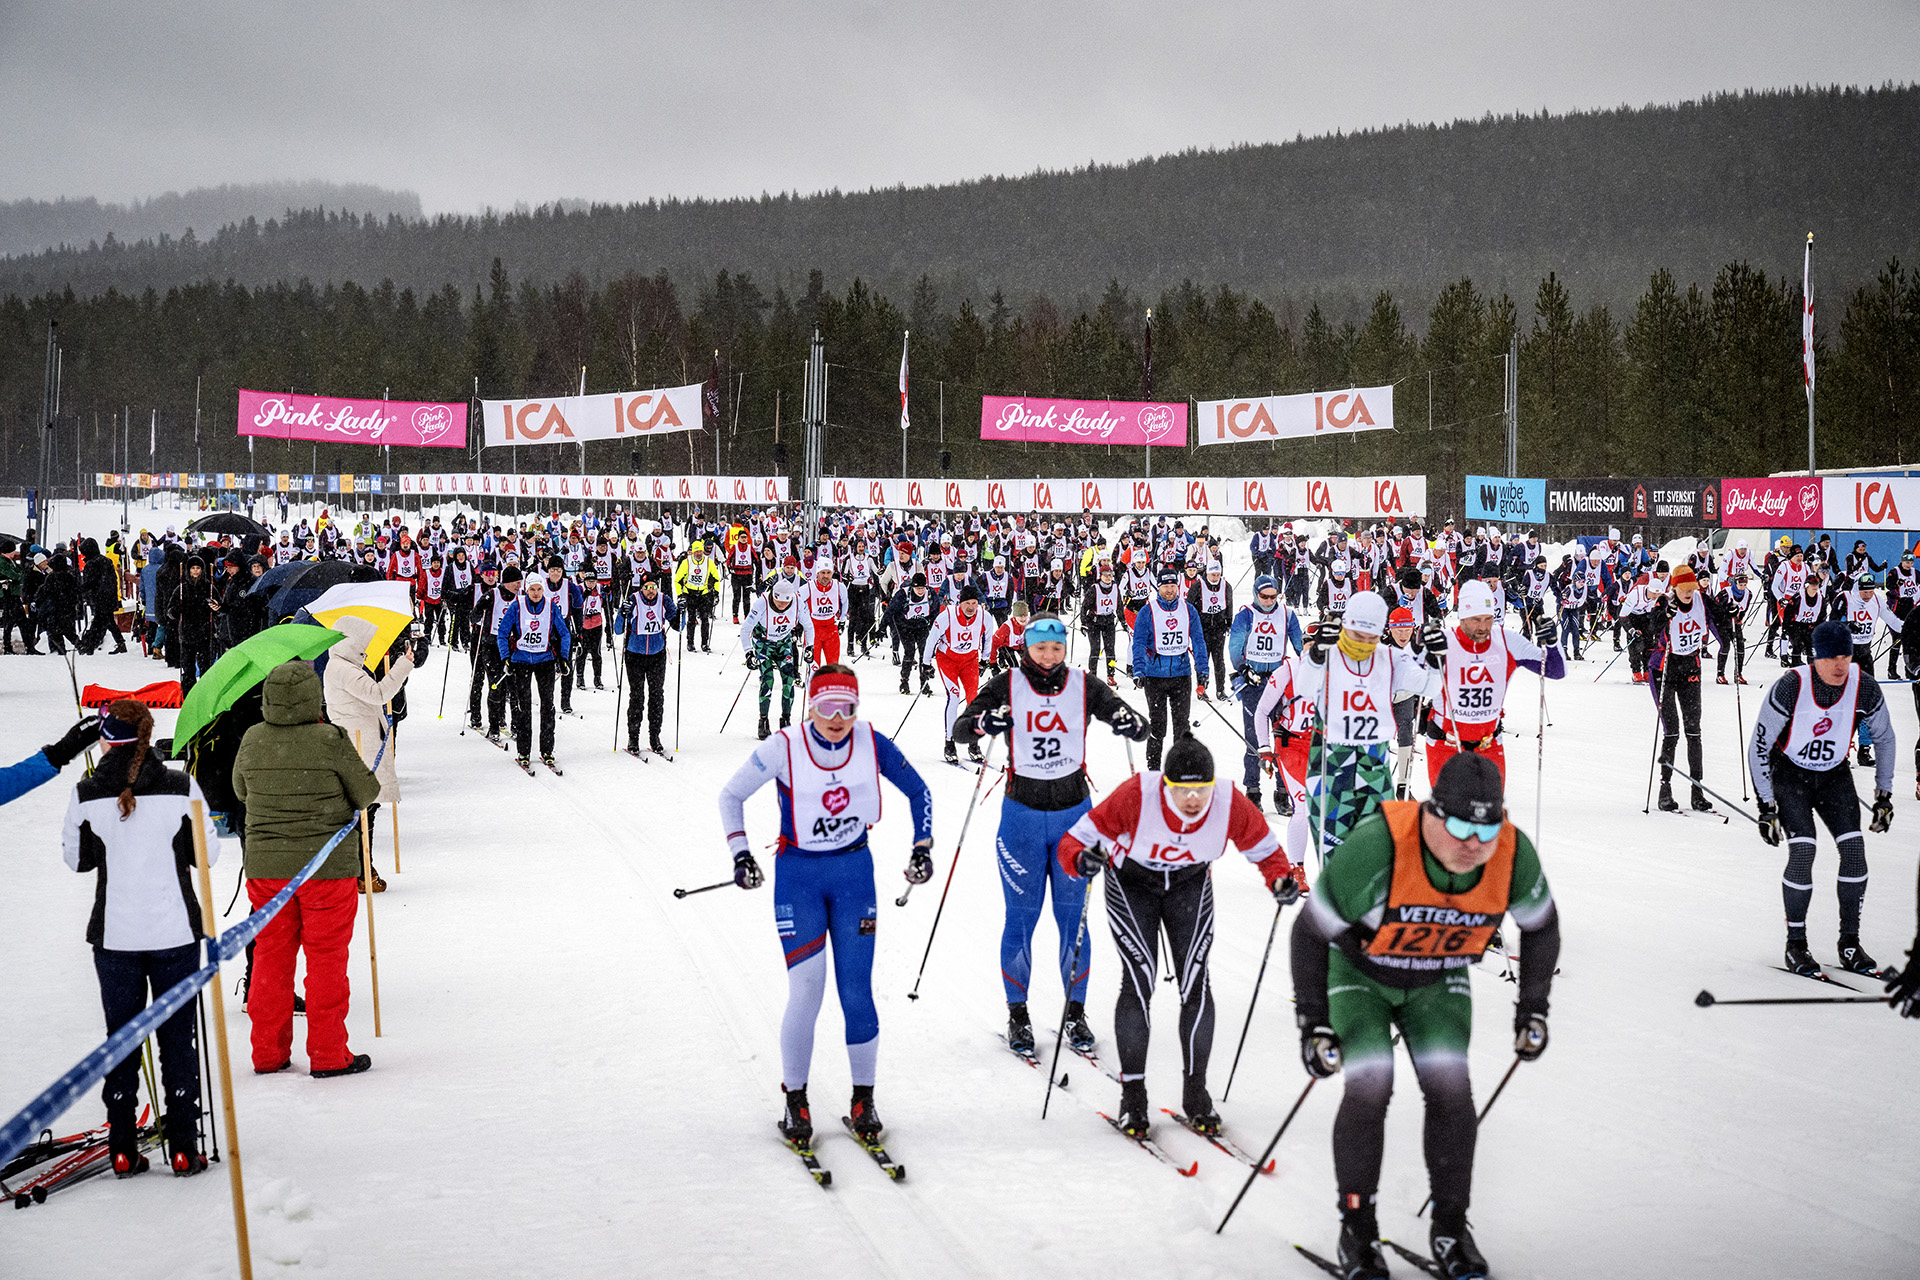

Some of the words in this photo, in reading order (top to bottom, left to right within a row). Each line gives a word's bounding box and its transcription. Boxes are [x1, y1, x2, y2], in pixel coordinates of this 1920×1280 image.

[254, 399, 324, 427] Pink
[418, 409, 445, 426] Pink
[503, 403, 575, 440] ICA
[614, 394, 683, 433] ICA
[995, 402, 1057, 431] Pink
[1143, 409, 1168, 425] Pink
[1217, 402, 1279, 439] ICA
[1315, 393, 1376, 431] ICA
[421, 420, 448, 434] Lady
[1147, 419, 1171, 433] Lady
[466, 476, 474, 492] ICA
[501, 476, 509, 493] ICA
[520, 477, 528, 494] ICA
[539, 477, 548, 495] ICA
[560, 477, 569, 496] ICA
[582, 477, 592, 496] ICA
[604, 478, 614, 497] ICA
[627, 478, 638, 498] ICA
[653, 478, 664, 499] ICA
[679, 479, 691, 499] ICA
[707, 479, 718, 500] ICA
[734, 479, 747, 501] ICA
[765, 479, 778, 501] ICA
[833, 480, 848, 504] ICA
[869, 481, 885, 505] ICA
[908, 481, 923, 506] ICA
[1500, 485, 1524, 500] wibe
[946, 482, 962, 508] ICA
[988, 482, 1006, 509] ICA
[1034, 482, 1053, 509] ICA
[1082, 481, 1102, 509] ICA
[1133, 481, 1154, 510] ICA
[1186, 481, 1209, 510] ICA
[1244, 481, 1268, 511] ICA
[1307, 481, 1332, 512] ICA
[1374, 480, 1403, 513] ICA
[1550, 491, 1567, 512] FM
[1569, 491, 1625, 513] Mattsson
[1653, 490, 1665, 503] ETT
[1666, 490, 1696, 503] SVENSKT
[1726, 488, 1758, 516] Pink
[1856, 481, 1902, 525] ICA
[1500, 500, 1529, 519] group
[1655, 504, 1693, 518] UNDERVERK
[1135, 582, 1147, 590] ICA
[817, 597, 832, 606] ICA
[1101, 598, 1113, 606] ICA
[773, 616, 790, 626] ICA
[1854, 610, 1873, 622] ICA
[958, 632, 973, 642] ICA
[1255, 622, 1277, 635] ICA
[1679, 620, 1701, 634] ICA
[524, 632, 542, 644] 465
[1162, 631, 1183, 645] 375
[1257, 636, 1273, 650] 50
[1679, 632, 1700, 647] 312
[1460, 666, 1494, 685] ICA
[1302, 700, 1316, 715] IC
[1343, 691, 1378, 712] ICA
[1458, 687, 1493, 708] 336
[1027, 711, 1068, 733] ICA
[1343, 716, 1378, 740] 122
[1033, 737, 1060, 761] 32
[1797, 739, 1836, 761] 485
[1149, 843, 1196, 862] ICA
[1400, 906, 1487, 927] VETERAN
